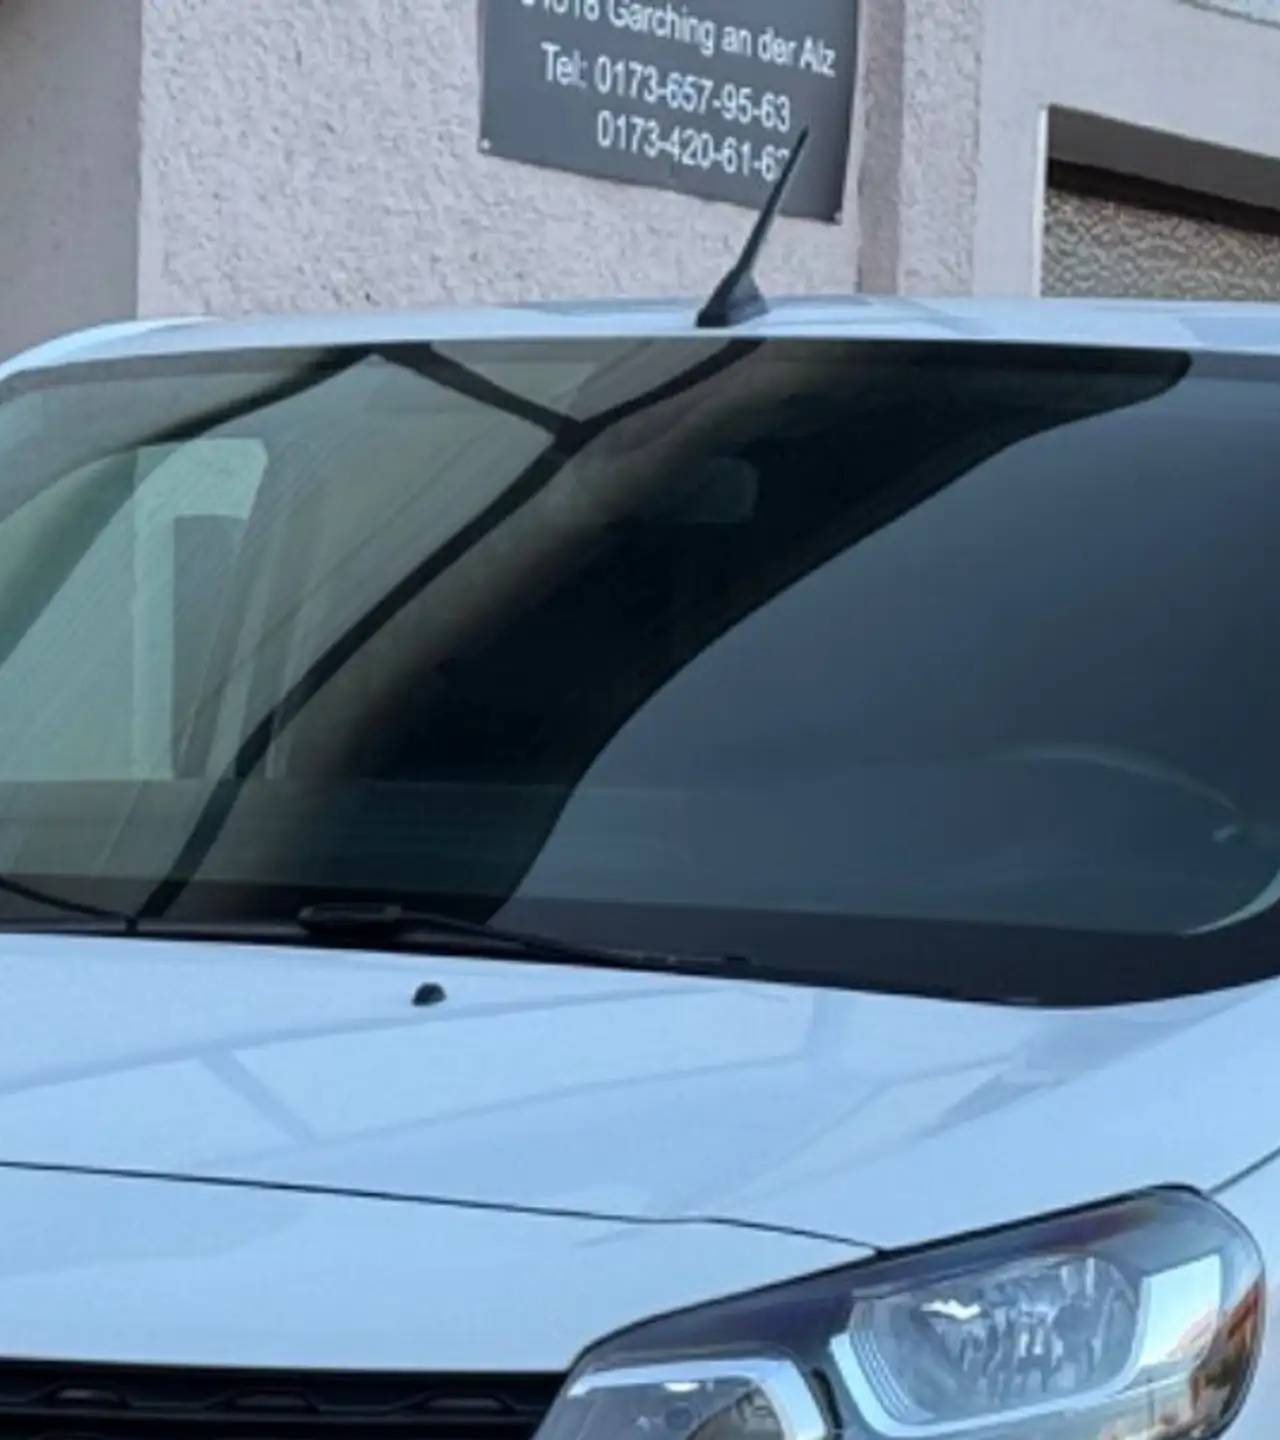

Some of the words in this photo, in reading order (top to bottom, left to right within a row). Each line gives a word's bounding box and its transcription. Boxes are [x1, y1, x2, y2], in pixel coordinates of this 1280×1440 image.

[607, 0, 717, 57] Garching
[722, 26, 752, 58] an
[757, 28, 798, 65] der
[799, 34, 837, 78] Alz
[594, 55, 791, 133] 0173-657-95-63
